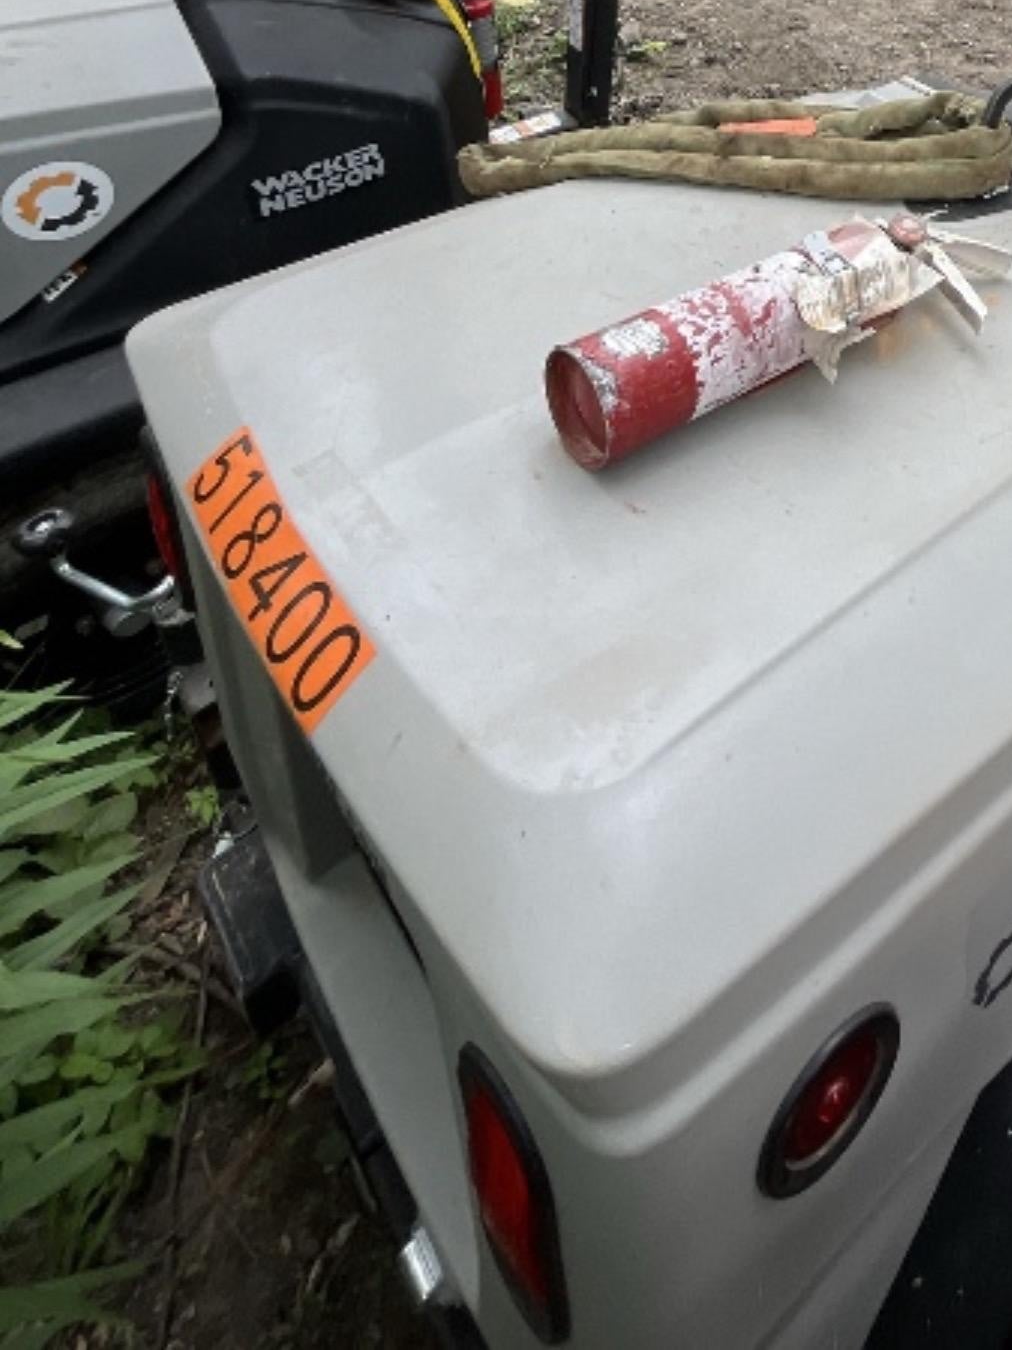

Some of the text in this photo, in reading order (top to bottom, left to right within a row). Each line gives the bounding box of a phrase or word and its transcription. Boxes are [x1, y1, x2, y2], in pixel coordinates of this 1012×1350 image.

[251, 143, 380, 196] WACKER
[260, 158, 386, 217] NEUSON
[193, 434, 361, 712] 518400
